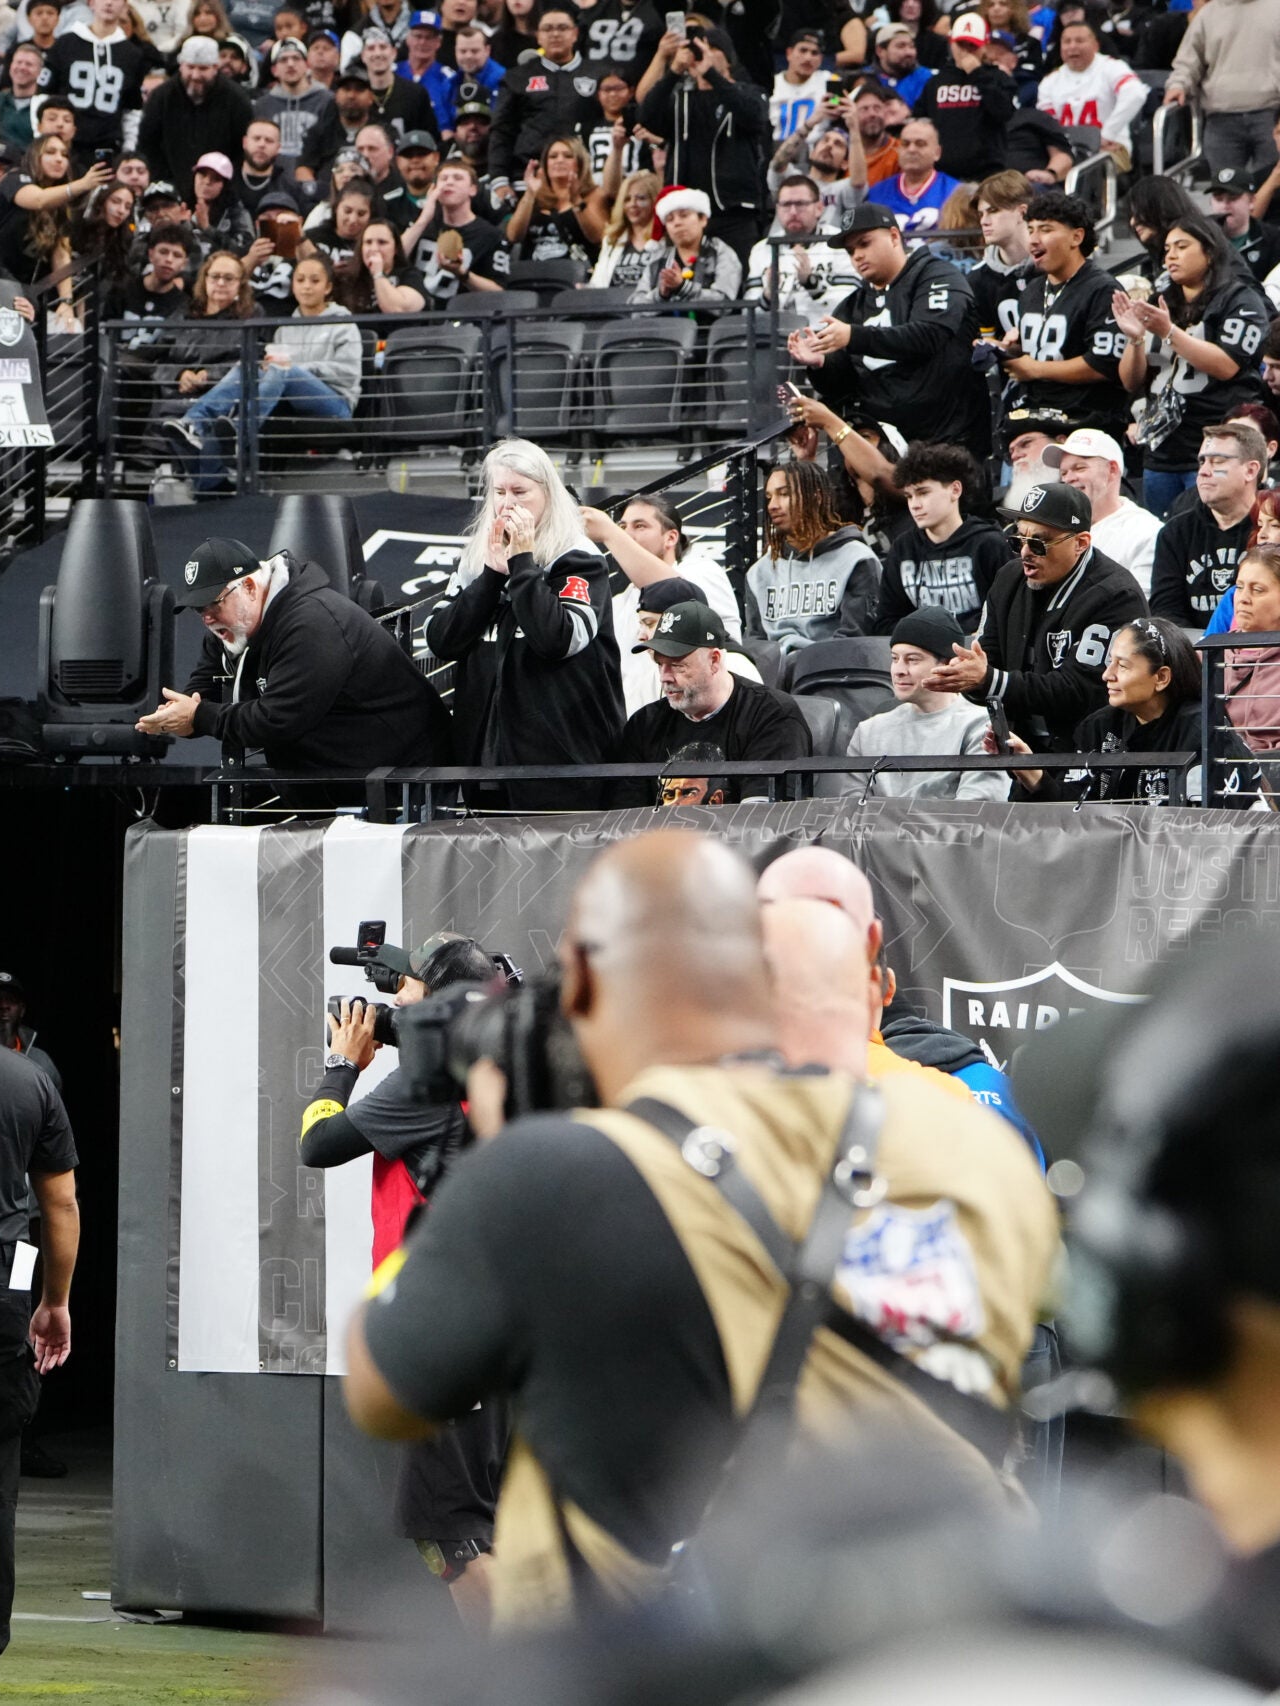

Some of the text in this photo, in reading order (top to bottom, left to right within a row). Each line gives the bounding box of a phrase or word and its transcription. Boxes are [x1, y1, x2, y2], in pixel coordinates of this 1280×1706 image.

[589, 17, 645, 61] 98
[69, 60, 123, 113] 98
[928, 289, 949, 310] 2
[1221, 318, 1262, 355] 98
[7, 426, 50, 446] CBS
[899, 555, 973, 587] RAIDER
